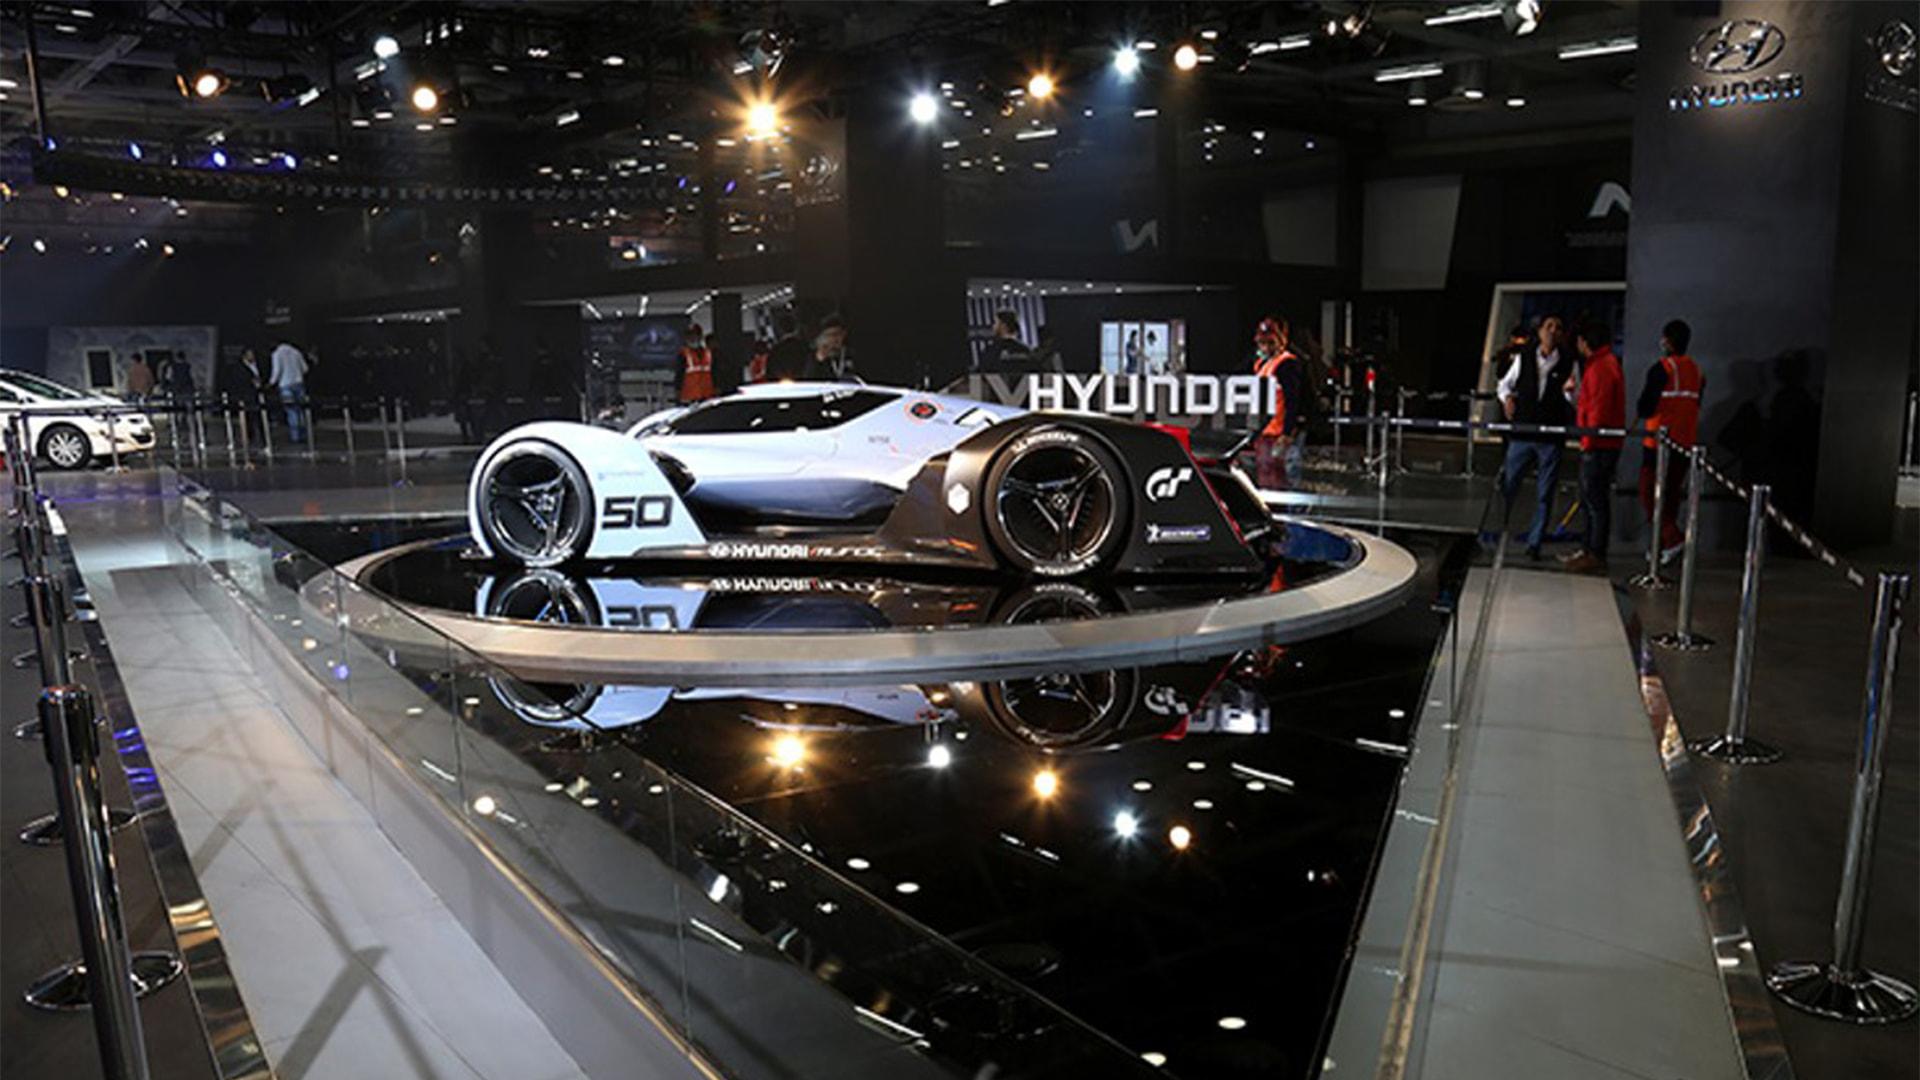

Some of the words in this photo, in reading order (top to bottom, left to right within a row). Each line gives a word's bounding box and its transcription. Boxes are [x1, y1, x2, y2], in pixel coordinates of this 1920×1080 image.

[1669, 73, 1803, 110] HYUNDAI
[1029, 373, 1277, 415] HYUNDAI
[602, 495, 673, 529] 50
[732, 544, 809, 557] HYUNDAI
